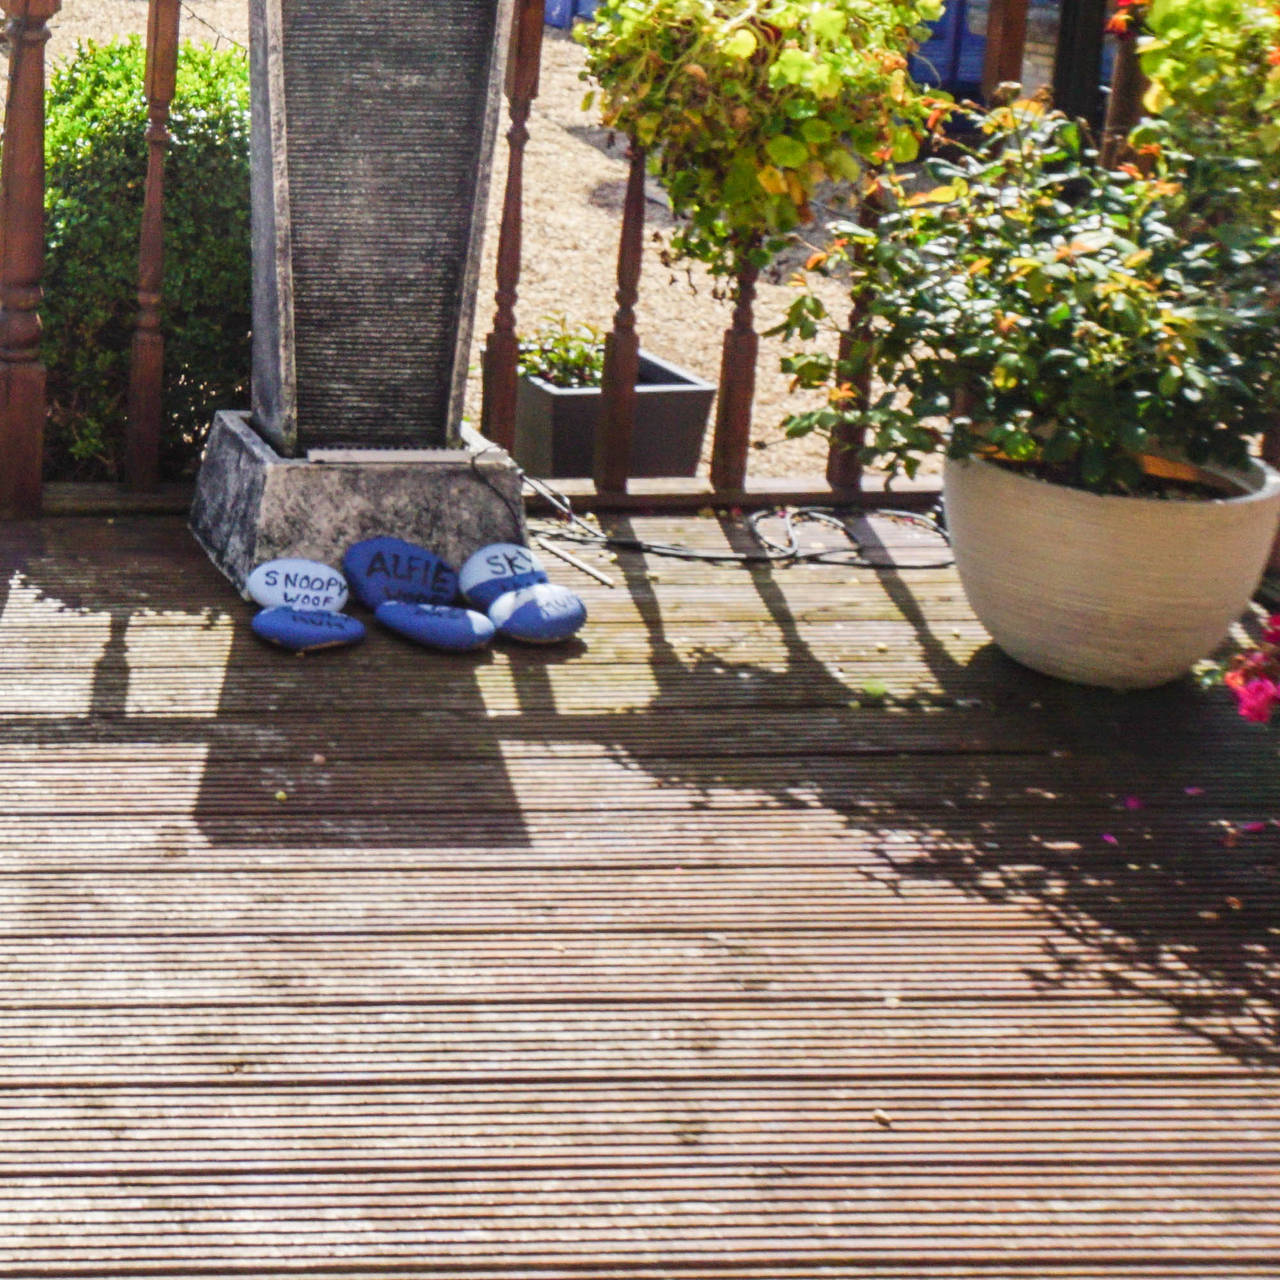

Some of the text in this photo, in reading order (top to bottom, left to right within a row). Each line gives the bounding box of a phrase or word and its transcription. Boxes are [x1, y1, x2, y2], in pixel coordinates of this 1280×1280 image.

[264, 571, 347, 596] SNOOPY
[366, 551, 453, 593] ALFIE
[283, 591, 334, 607] WOOF
